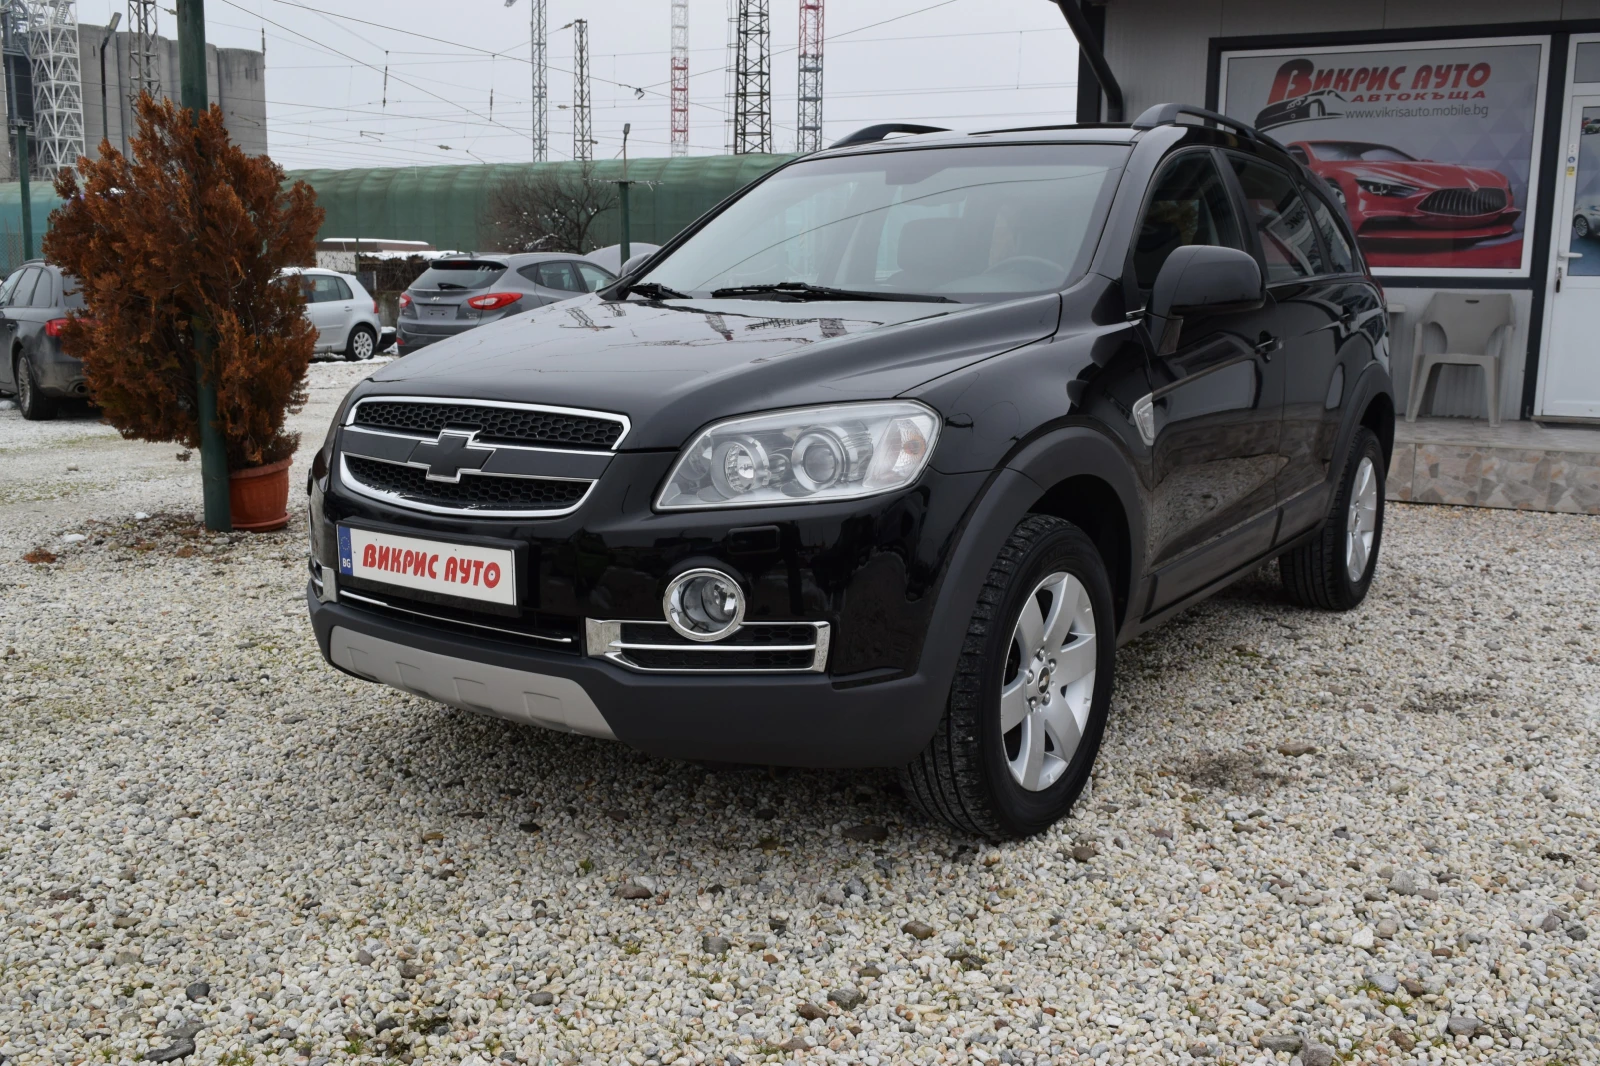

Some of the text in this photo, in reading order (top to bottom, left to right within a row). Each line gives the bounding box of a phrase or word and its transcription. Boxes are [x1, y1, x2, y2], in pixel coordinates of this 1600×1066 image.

[1411, 62, 1491, 90] АУТО
[1350, 90, 1486, 103] АВТОКЪЩА
[1345, 103, 1489, 119] www.vikrisauto.mobile.bg
[342, 557, 351, 568] BG
[362, 543, 501, 589] ВИКРИС АУТО
